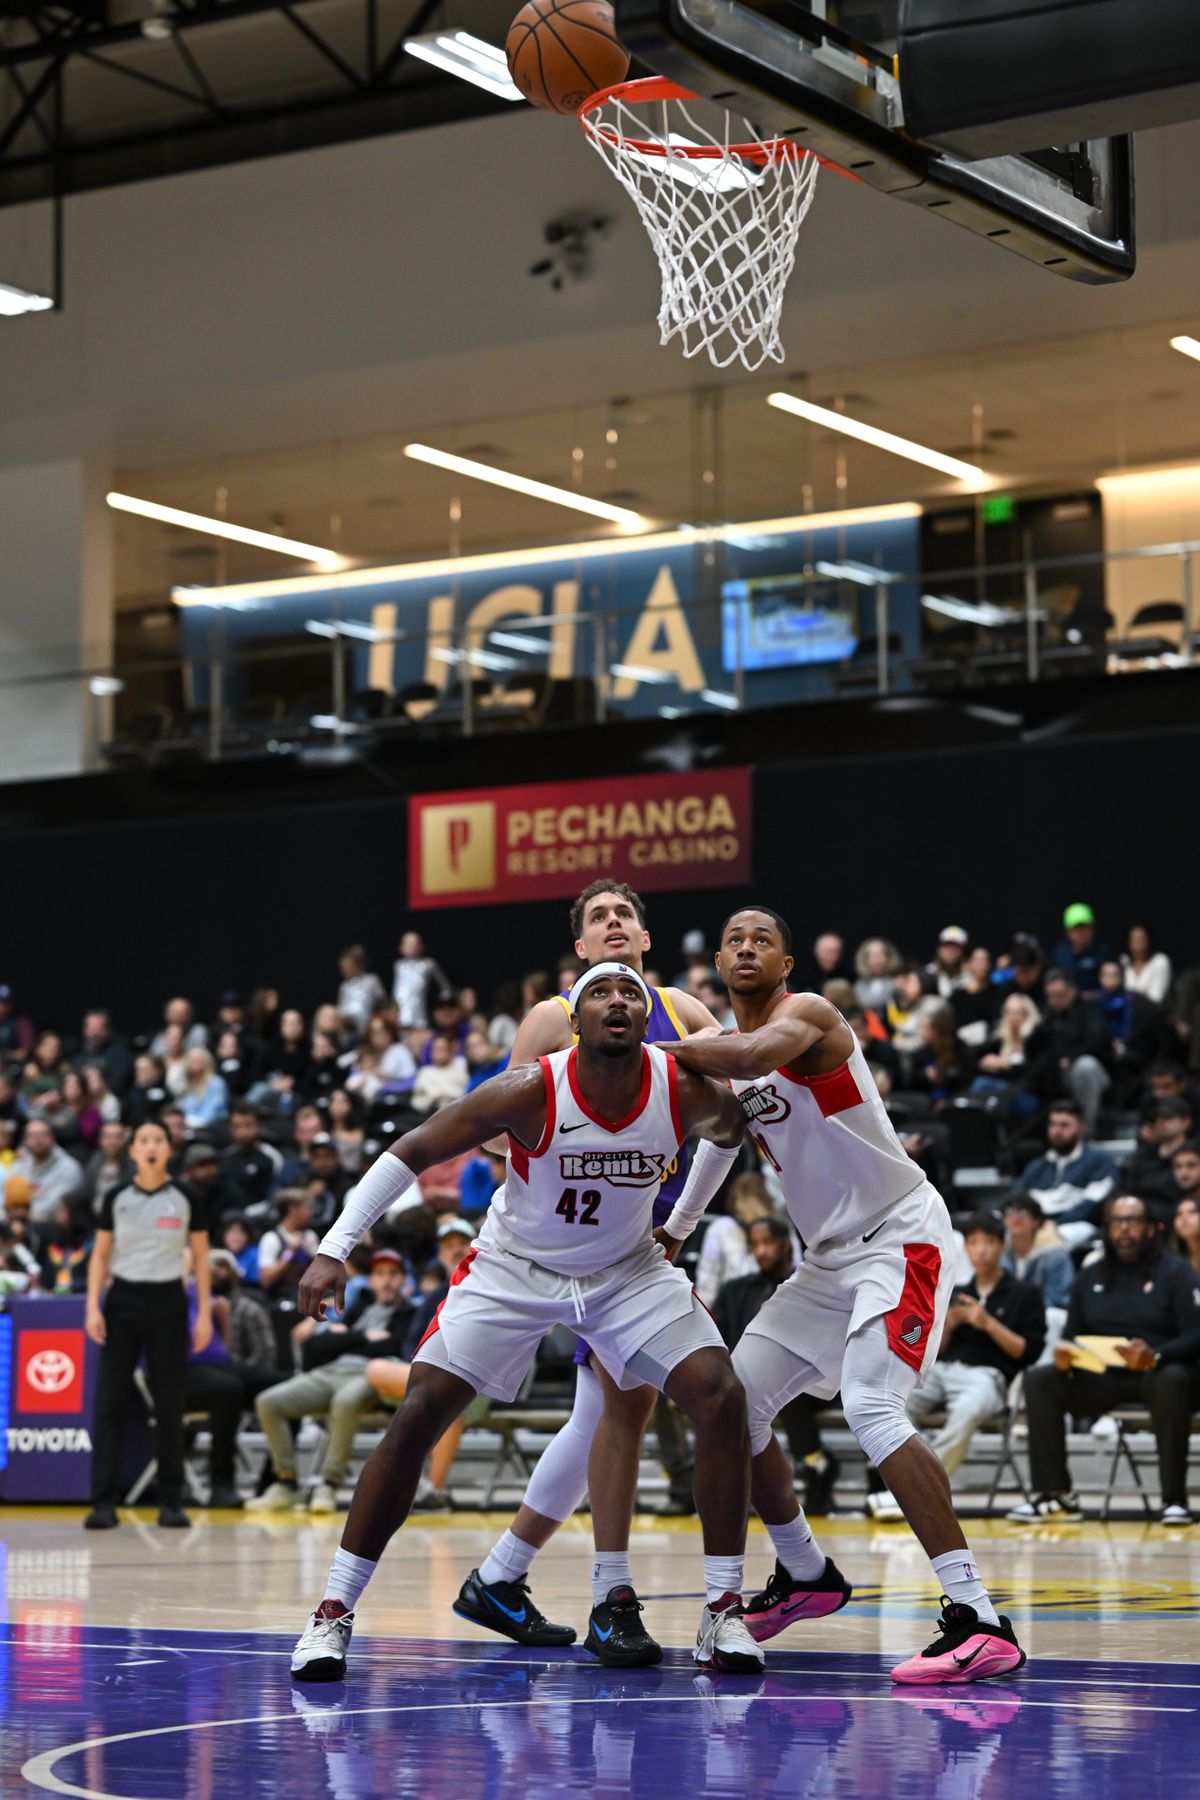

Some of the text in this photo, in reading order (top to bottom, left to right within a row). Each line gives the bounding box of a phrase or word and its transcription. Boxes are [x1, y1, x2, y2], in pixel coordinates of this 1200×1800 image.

[508, 794, 736, 847] PECHANGA
[508, 834, 740, 875] RESORT CASINO
[742, 1086, 790, 1124] emix
[561, 1152, 663, 1187] Remix
[555, 1187, 601, 1226] 42
[6, 1427, 93, 1452] TOYOTA
